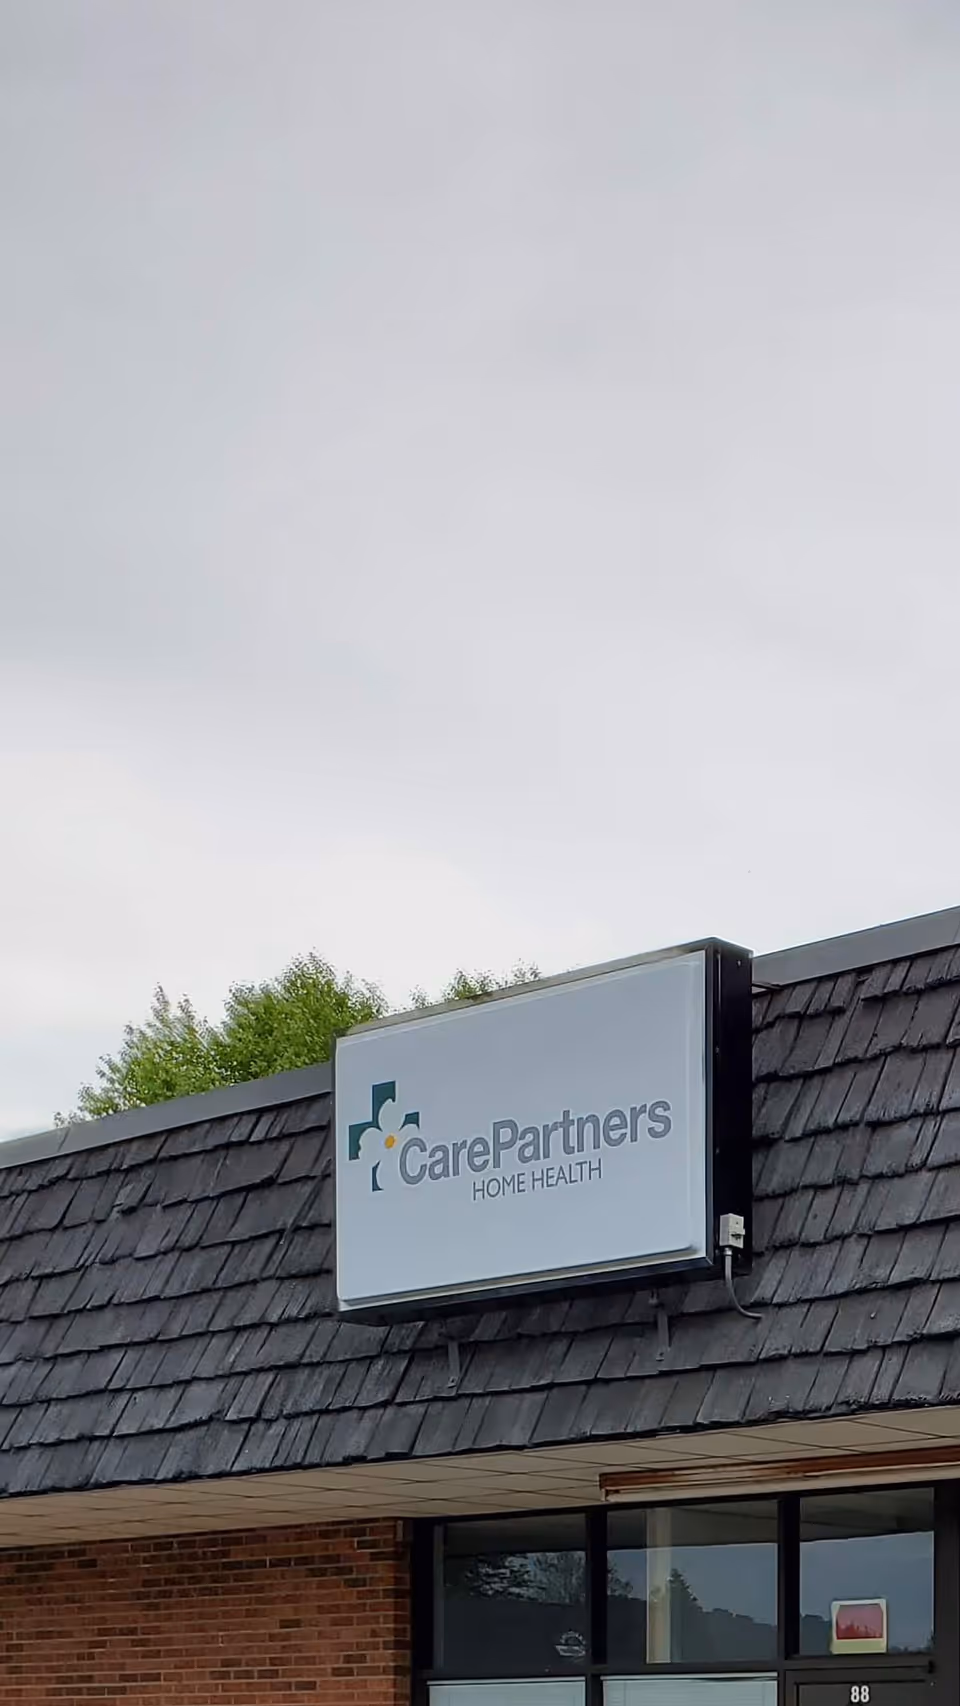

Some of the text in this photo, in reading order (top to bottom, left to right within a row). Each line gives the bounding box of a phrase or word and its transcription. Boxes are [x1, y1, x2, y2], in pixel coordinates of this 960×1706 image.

[400, 1100, 671, 1185] CarePartners
[473, 1157, 601, 1201] HOME HEALTH
[850, 1685, 870, 1703] 88
